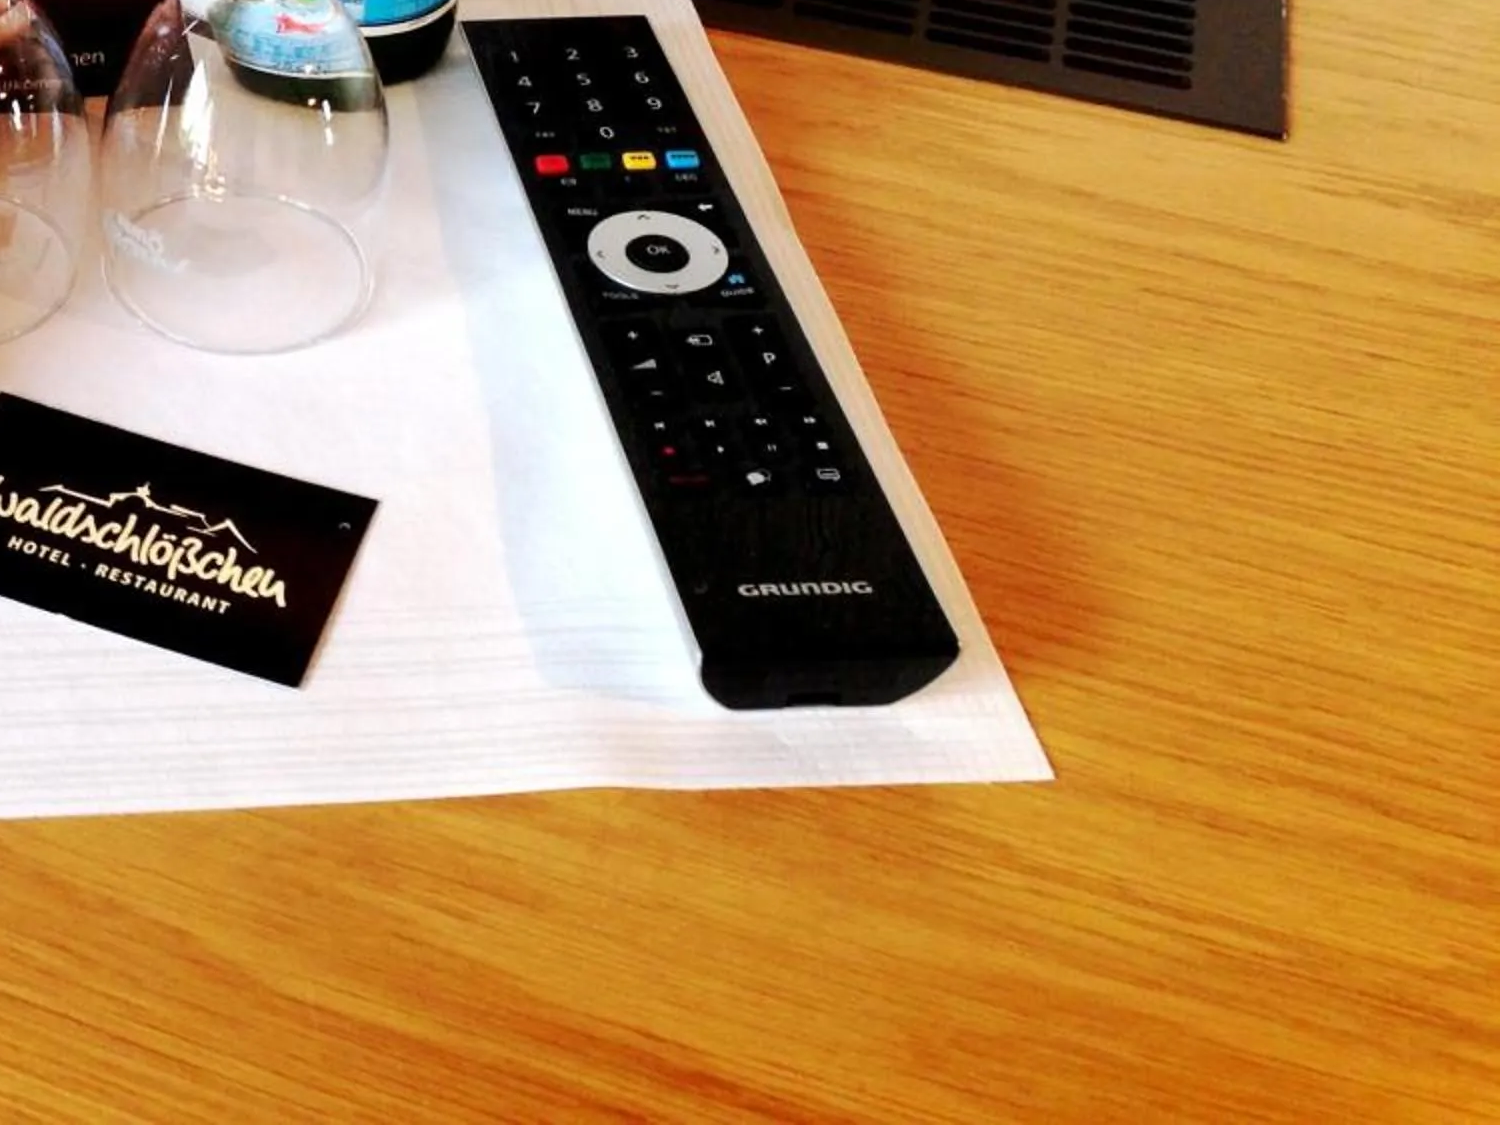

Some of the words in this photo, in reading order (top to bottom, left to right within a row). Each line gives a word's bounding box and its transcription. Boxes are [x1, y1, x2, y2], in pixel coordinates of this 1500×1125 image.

[510, 50, 520, 63] 1
[566, 48, 580, 61] 2
[624, 46, 639, 59] 3
[518, 75, 532, 87] 4
[576, 73, 591, 86] 5
[635, 71, 649, 84] 6
[526, 101, 541, 115] 7
[587, 99, 603, 112] 8
[647, 97, 662, 110] 9
[646, 244, 671, 256] OK
[6, 534, 71, 568] HOTEL
[95, 562, 232, 615] RESTAURANT
[737, 580, 874, 597] GRUNDIG
